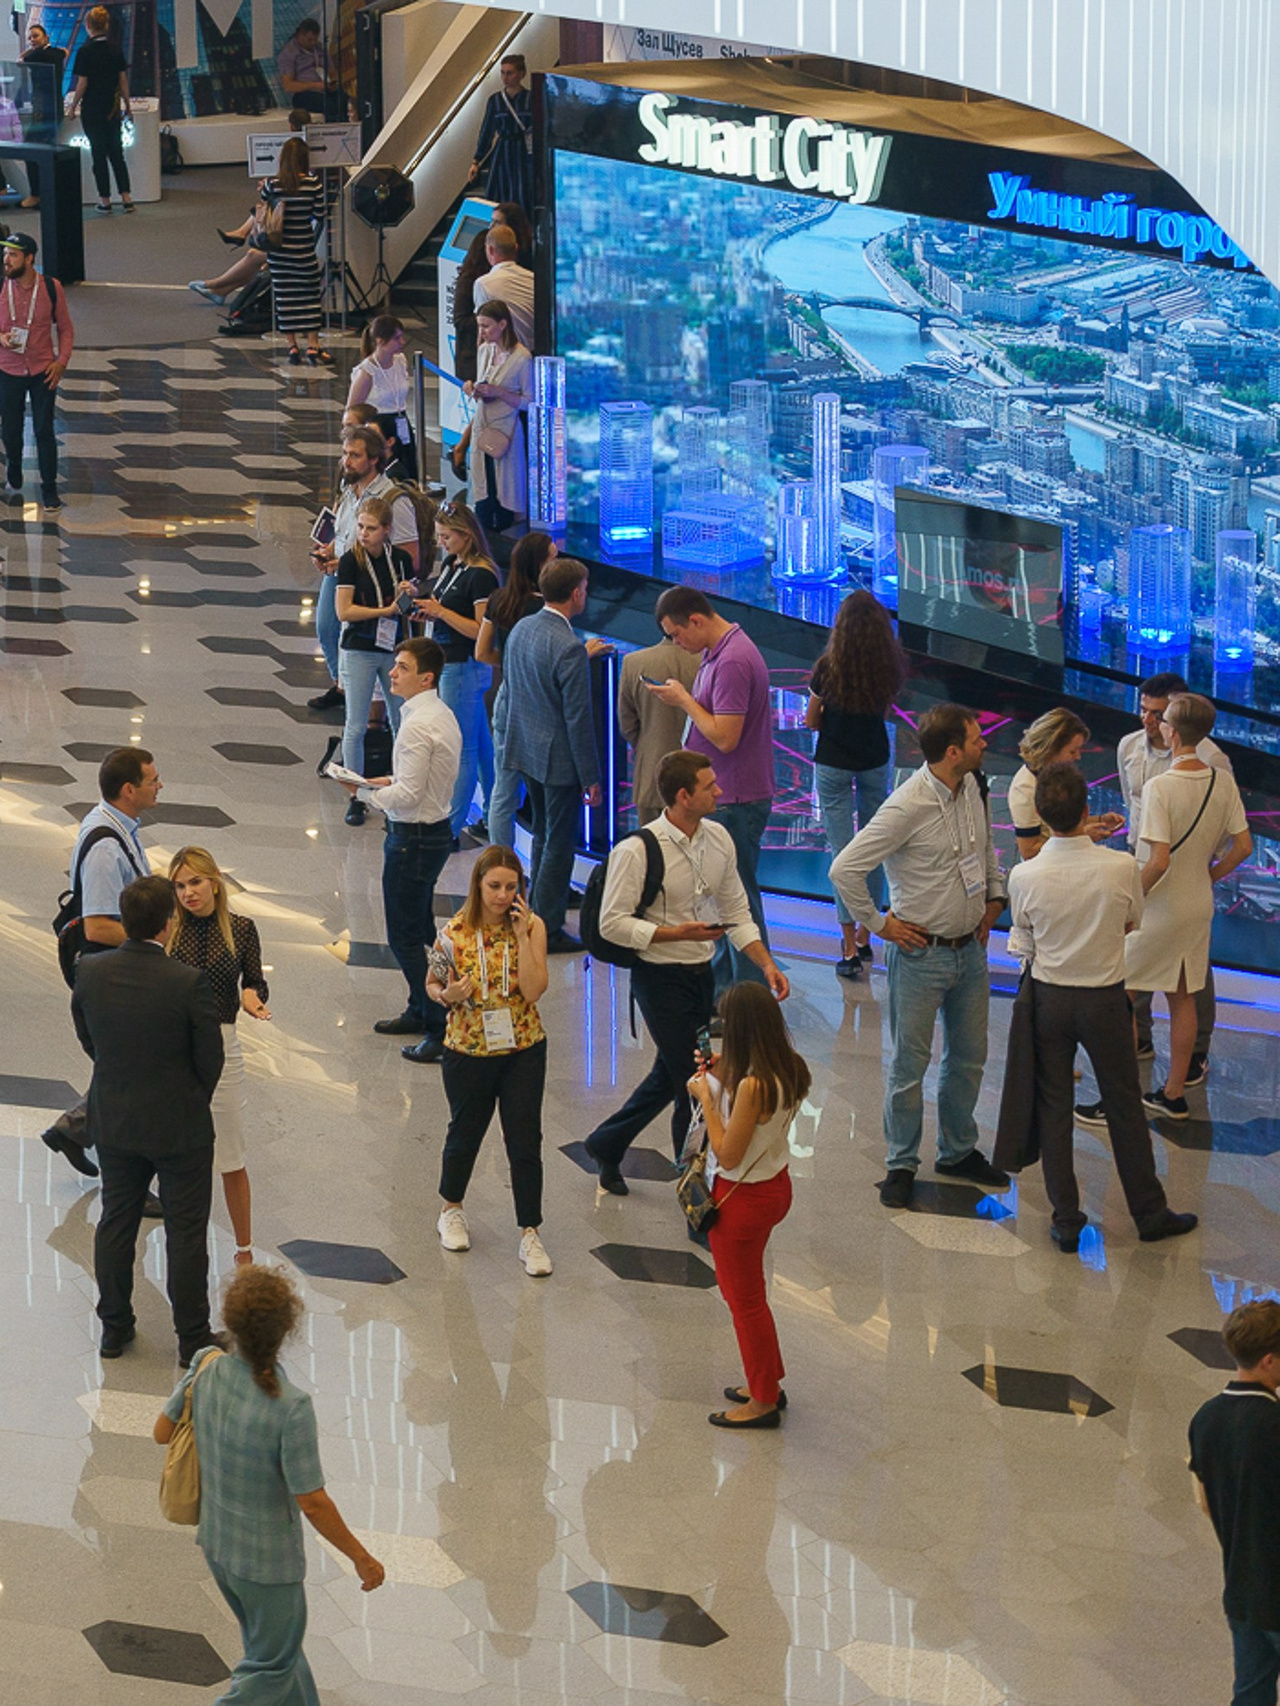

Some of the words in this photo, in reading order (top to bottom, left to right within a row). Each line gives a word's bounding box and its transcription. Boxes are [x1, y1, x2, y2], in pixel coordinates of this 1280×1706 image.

[637, 27, 660, 50] Зал
[661, 33, 703, 58] Щусев
[638, 93, 784, 182] Smart
[783, 117, 893, 204] City
[987, 171, 1138, 239] Умный
